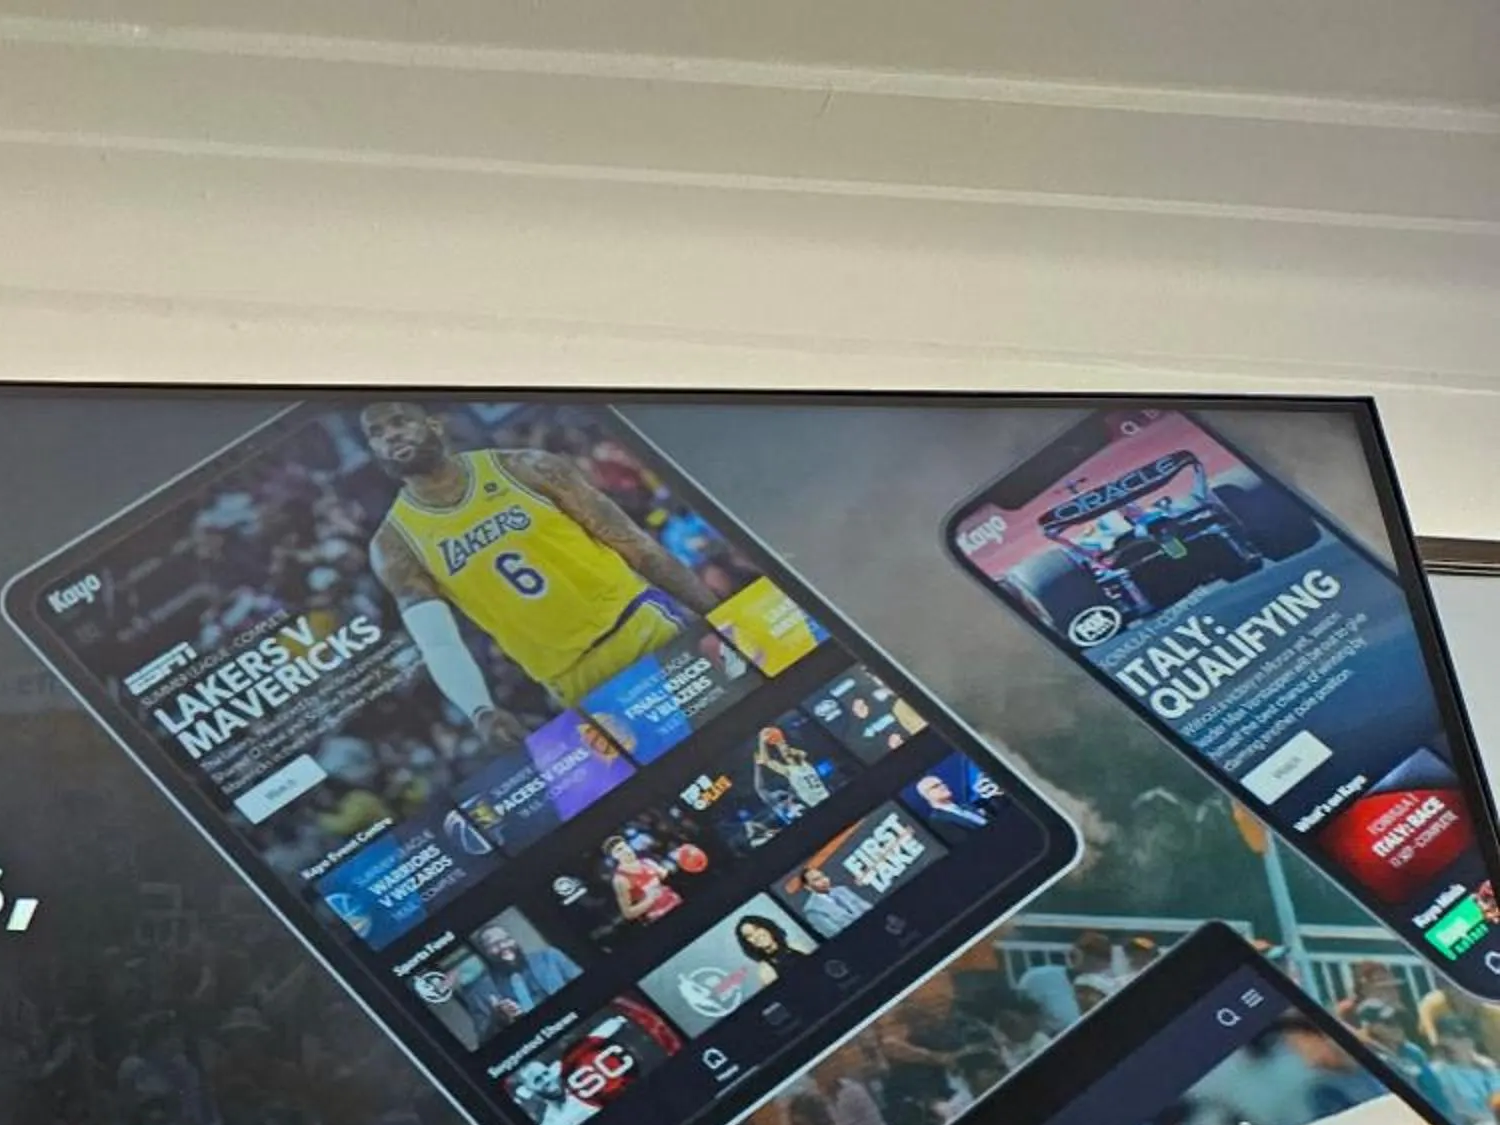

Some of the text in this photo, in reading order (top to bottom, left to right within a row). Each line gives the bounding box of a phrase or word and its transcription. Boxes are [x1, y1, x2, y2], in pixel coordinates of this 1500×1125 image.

[1053, 456, 1176, 520] ORACLE
[437, 504, 532, 576] LAKERS
[955, 514, 1008, 557] Kayo
[48, 573, 101, 613] Kayo
[494, 551, 546, 598] 6
[154, 636, 289, 735] LAKERS
[281, 615, 316, 648] V
[1115, 614, 1227, 698] ITALY:
[1150, 569, 1341, 721] QUALIFYING
[176, 615, 382, 760] MAVERICKS
[1409, 796, 1446, 828] RACE
[842, 812, 913, 886] FIRST
[866, 834, 926, 893] TAKE
[566, 1043, 636, 1099] SC
